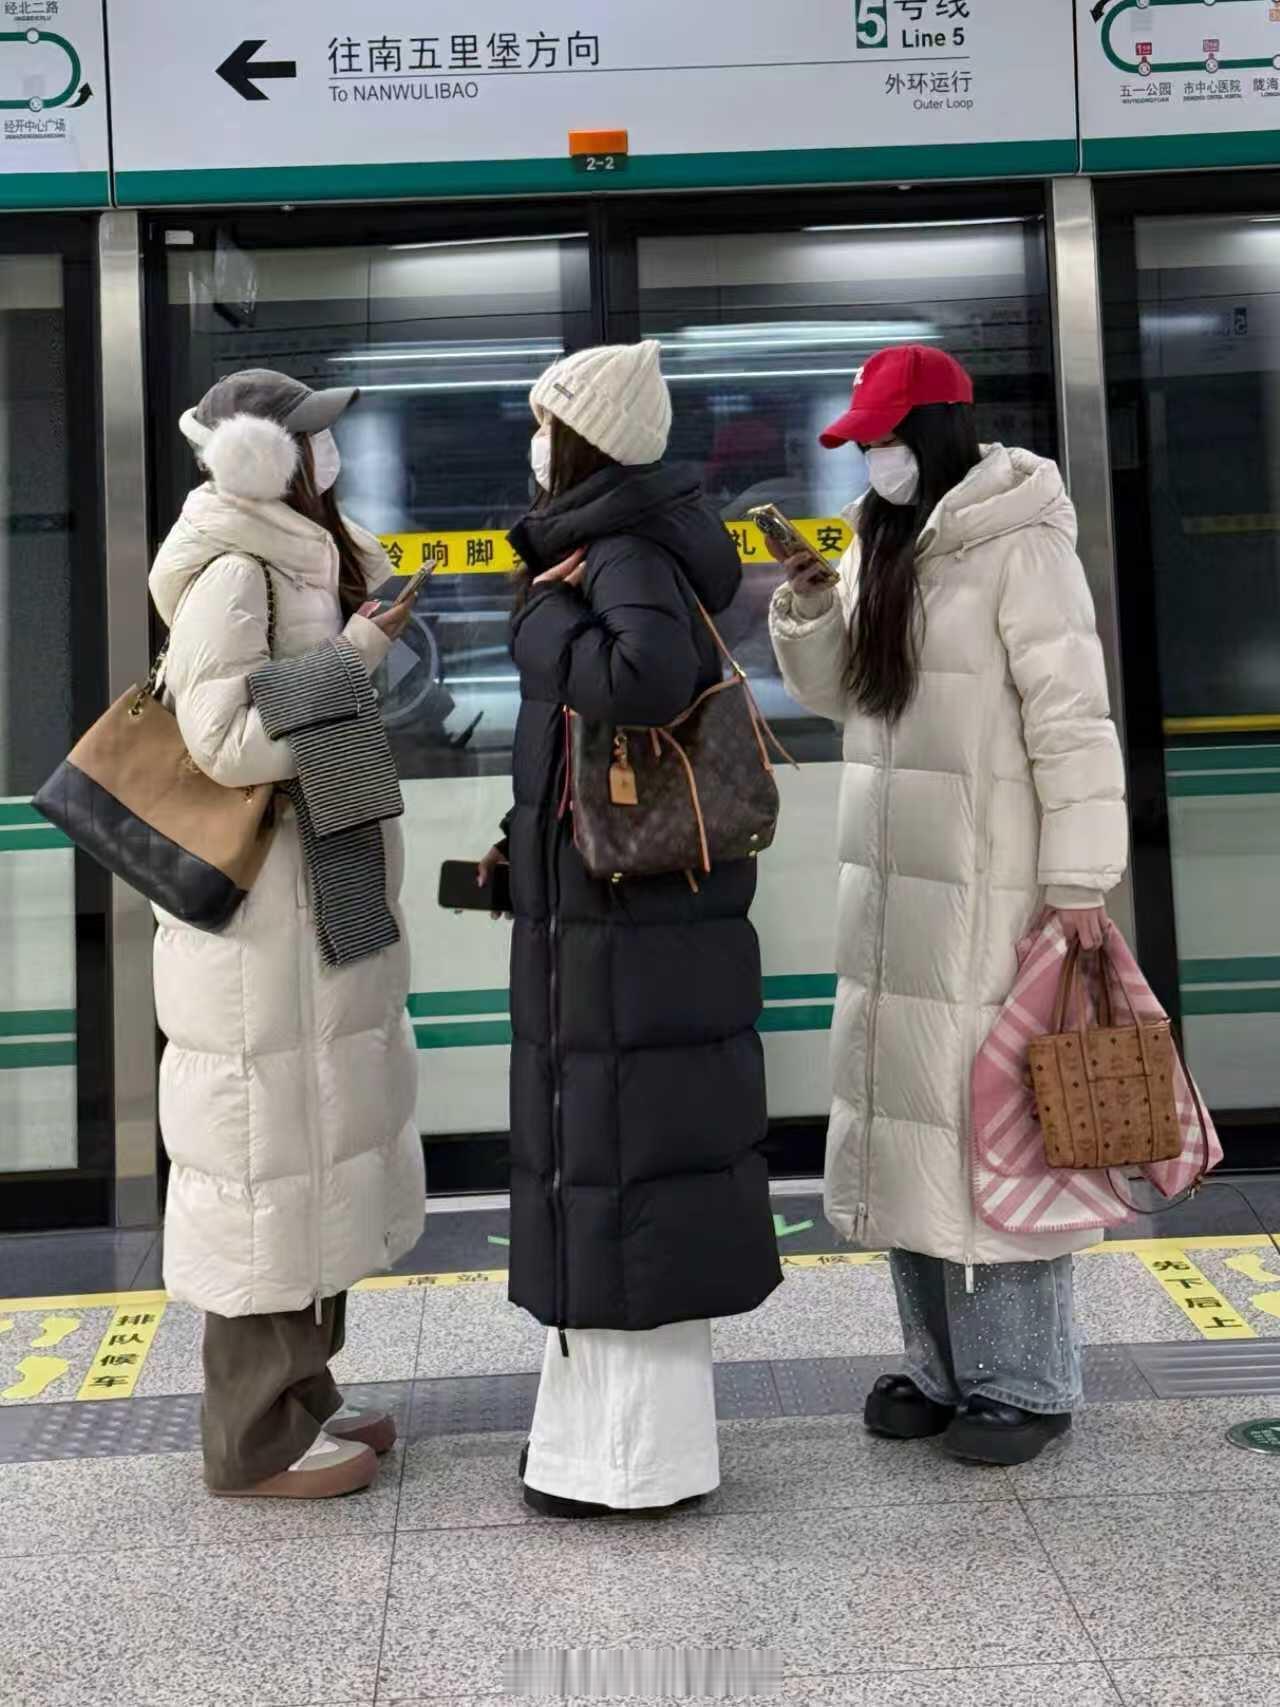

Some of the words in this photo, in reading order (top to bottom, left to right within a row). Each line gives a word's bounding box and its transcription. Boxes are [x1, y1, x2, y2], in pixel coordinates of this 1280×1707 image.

[5, 0, 58, 15] 经北二路
[857, 0, 887, 46] 5
[902, 29, 946, 48] Line
[952, 27, 965, 46] 5
[328, 30, 600, 75] 往南五里堡方向
[328, 86, 348, 102] To
[354, 81, 479, 101] NANWULIBAO
[885, 70, 973, 94] 外环运行
[1120, 82, 1171, 97] 五一公园
[1184, 80, 1241, 94] 市中心医院
[913, 99, 943, 110] Outer
[946, 98, 974, 110] Loop
[4, 119, 65, 133] 经开中心广场
[586, 156, 615, 170] 2-2
[1152, 1260, 1243, 1328] 先下后上
[88, 1313, 156, 1388] 排队候车
